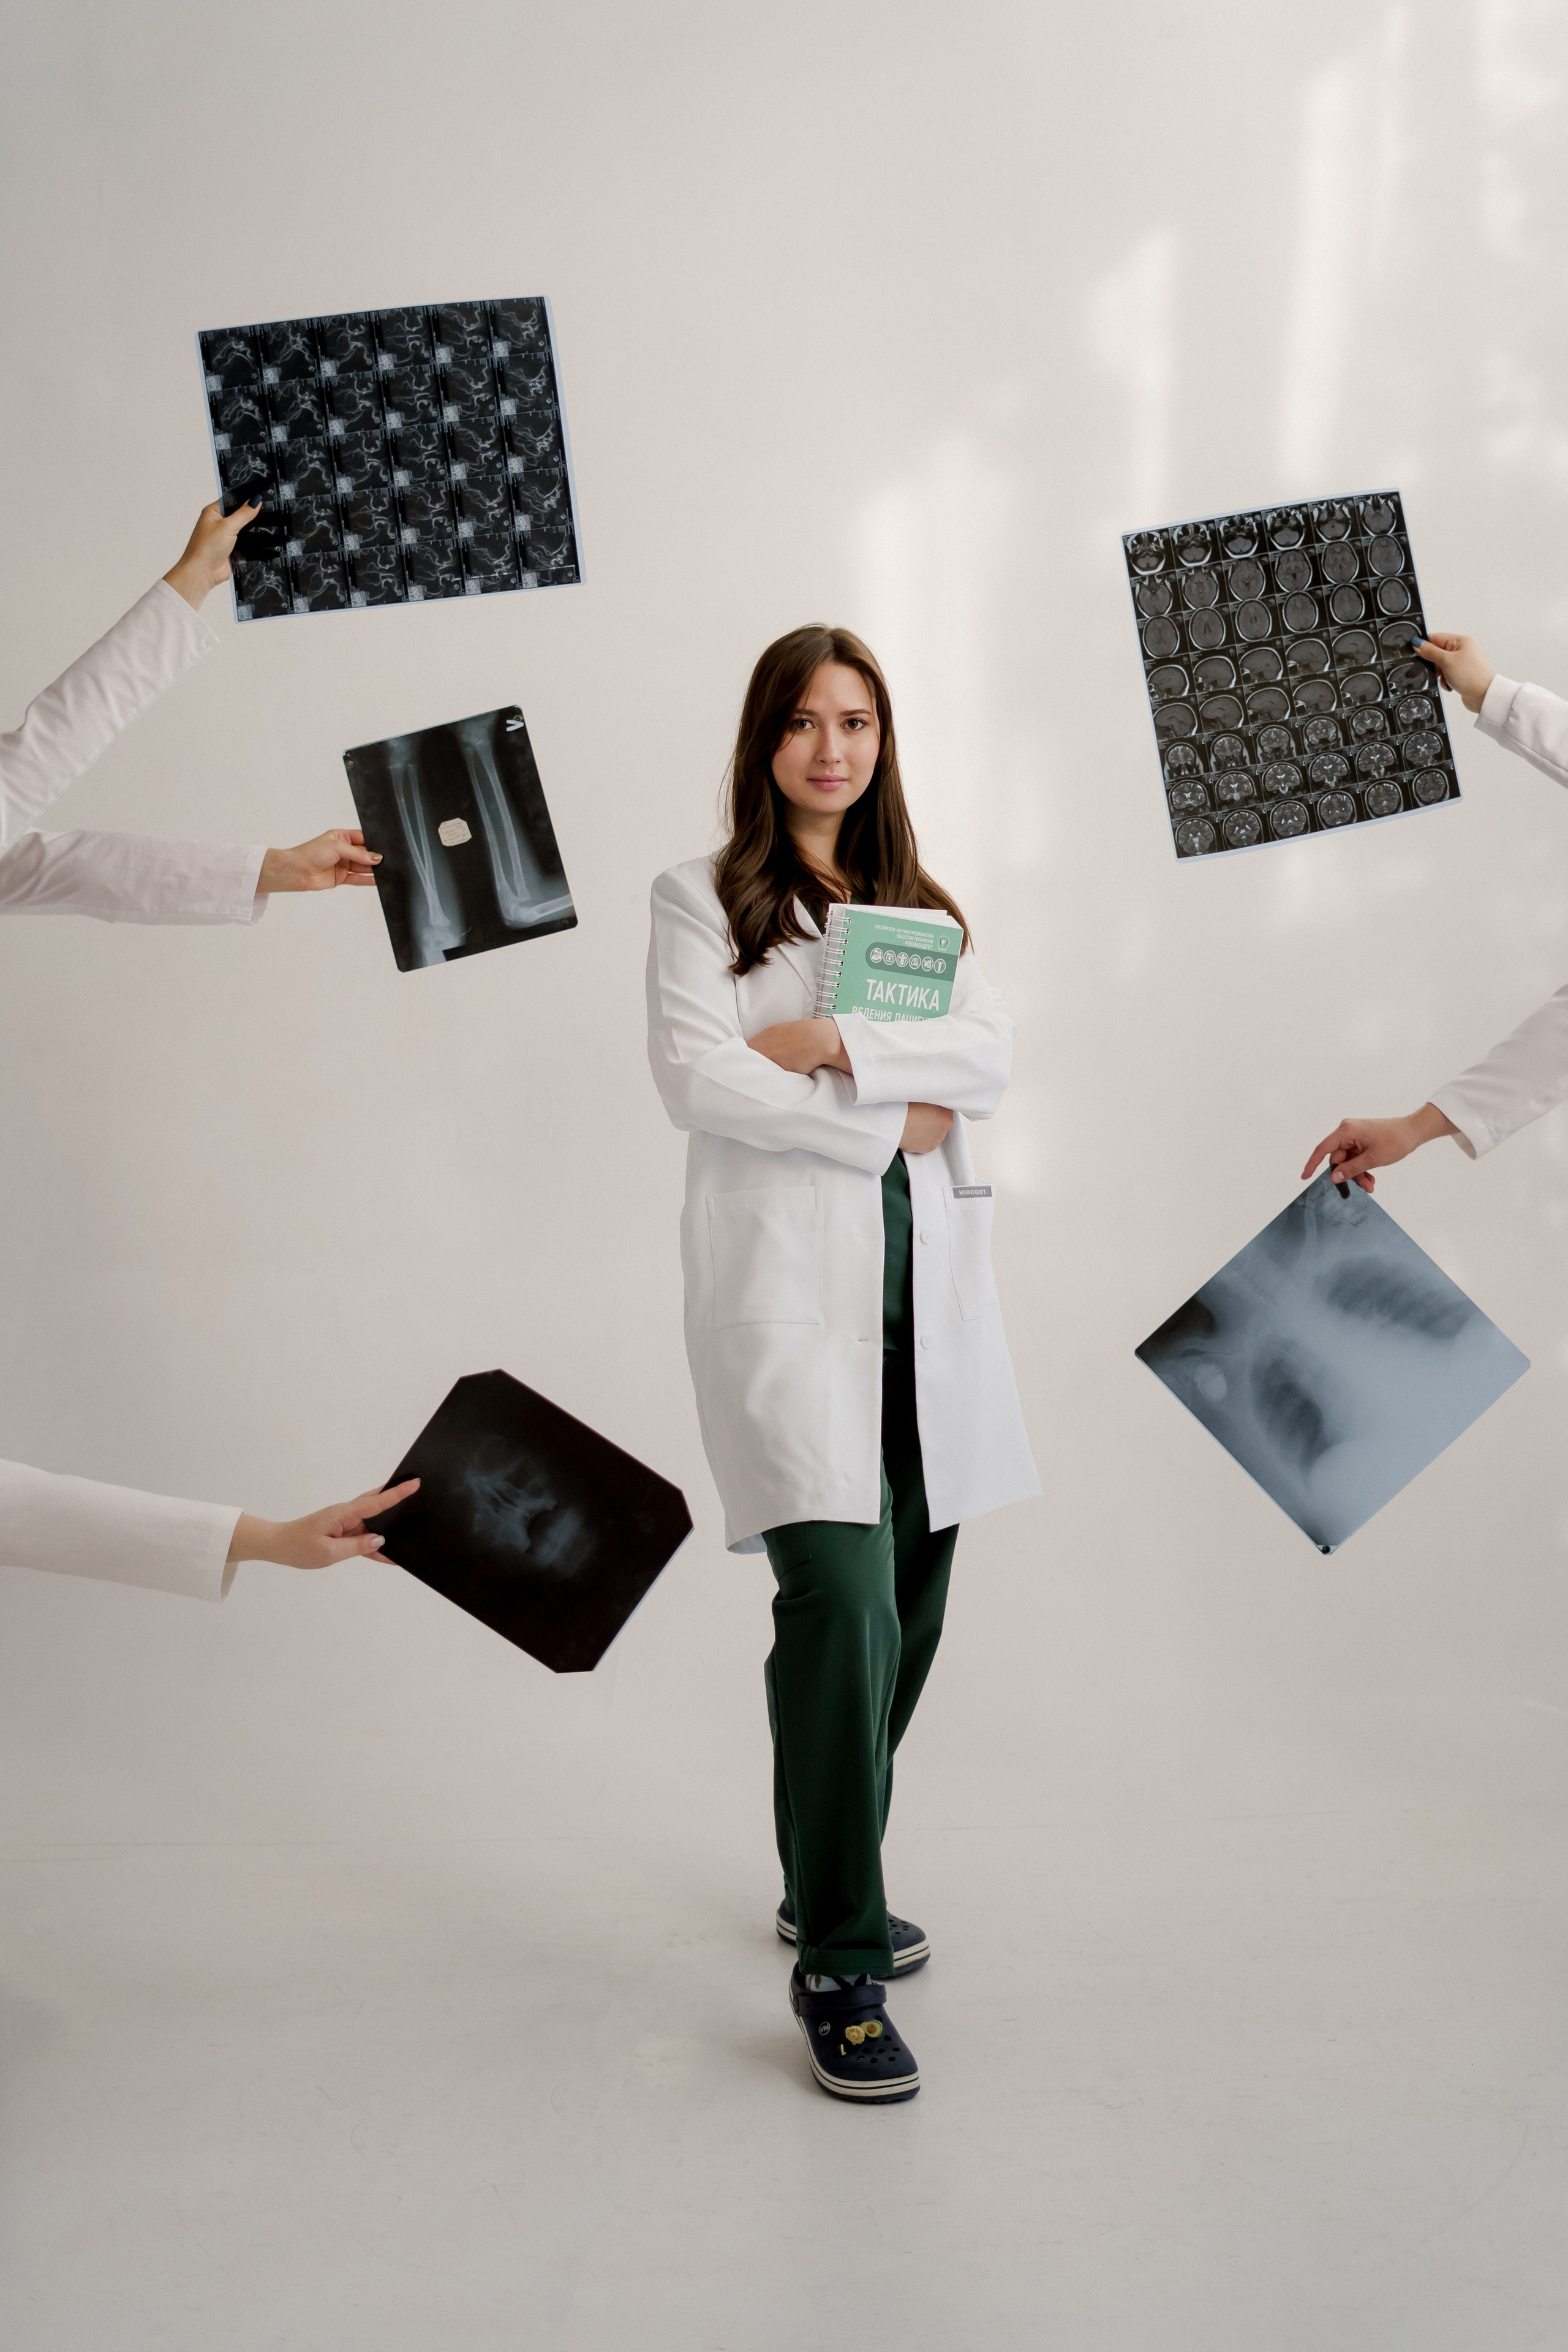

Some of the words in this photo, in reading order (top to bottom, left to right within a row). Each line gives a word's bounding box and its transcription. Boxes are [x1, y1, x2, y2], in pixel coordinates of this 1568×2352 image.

[905, 940, 933, 950] РЕКОМЕНДУЕТ
[866, 978, 940, 1011] ТАКТИКА
[851, 1006, 892, 1022] ВЕДЕНИЯ
